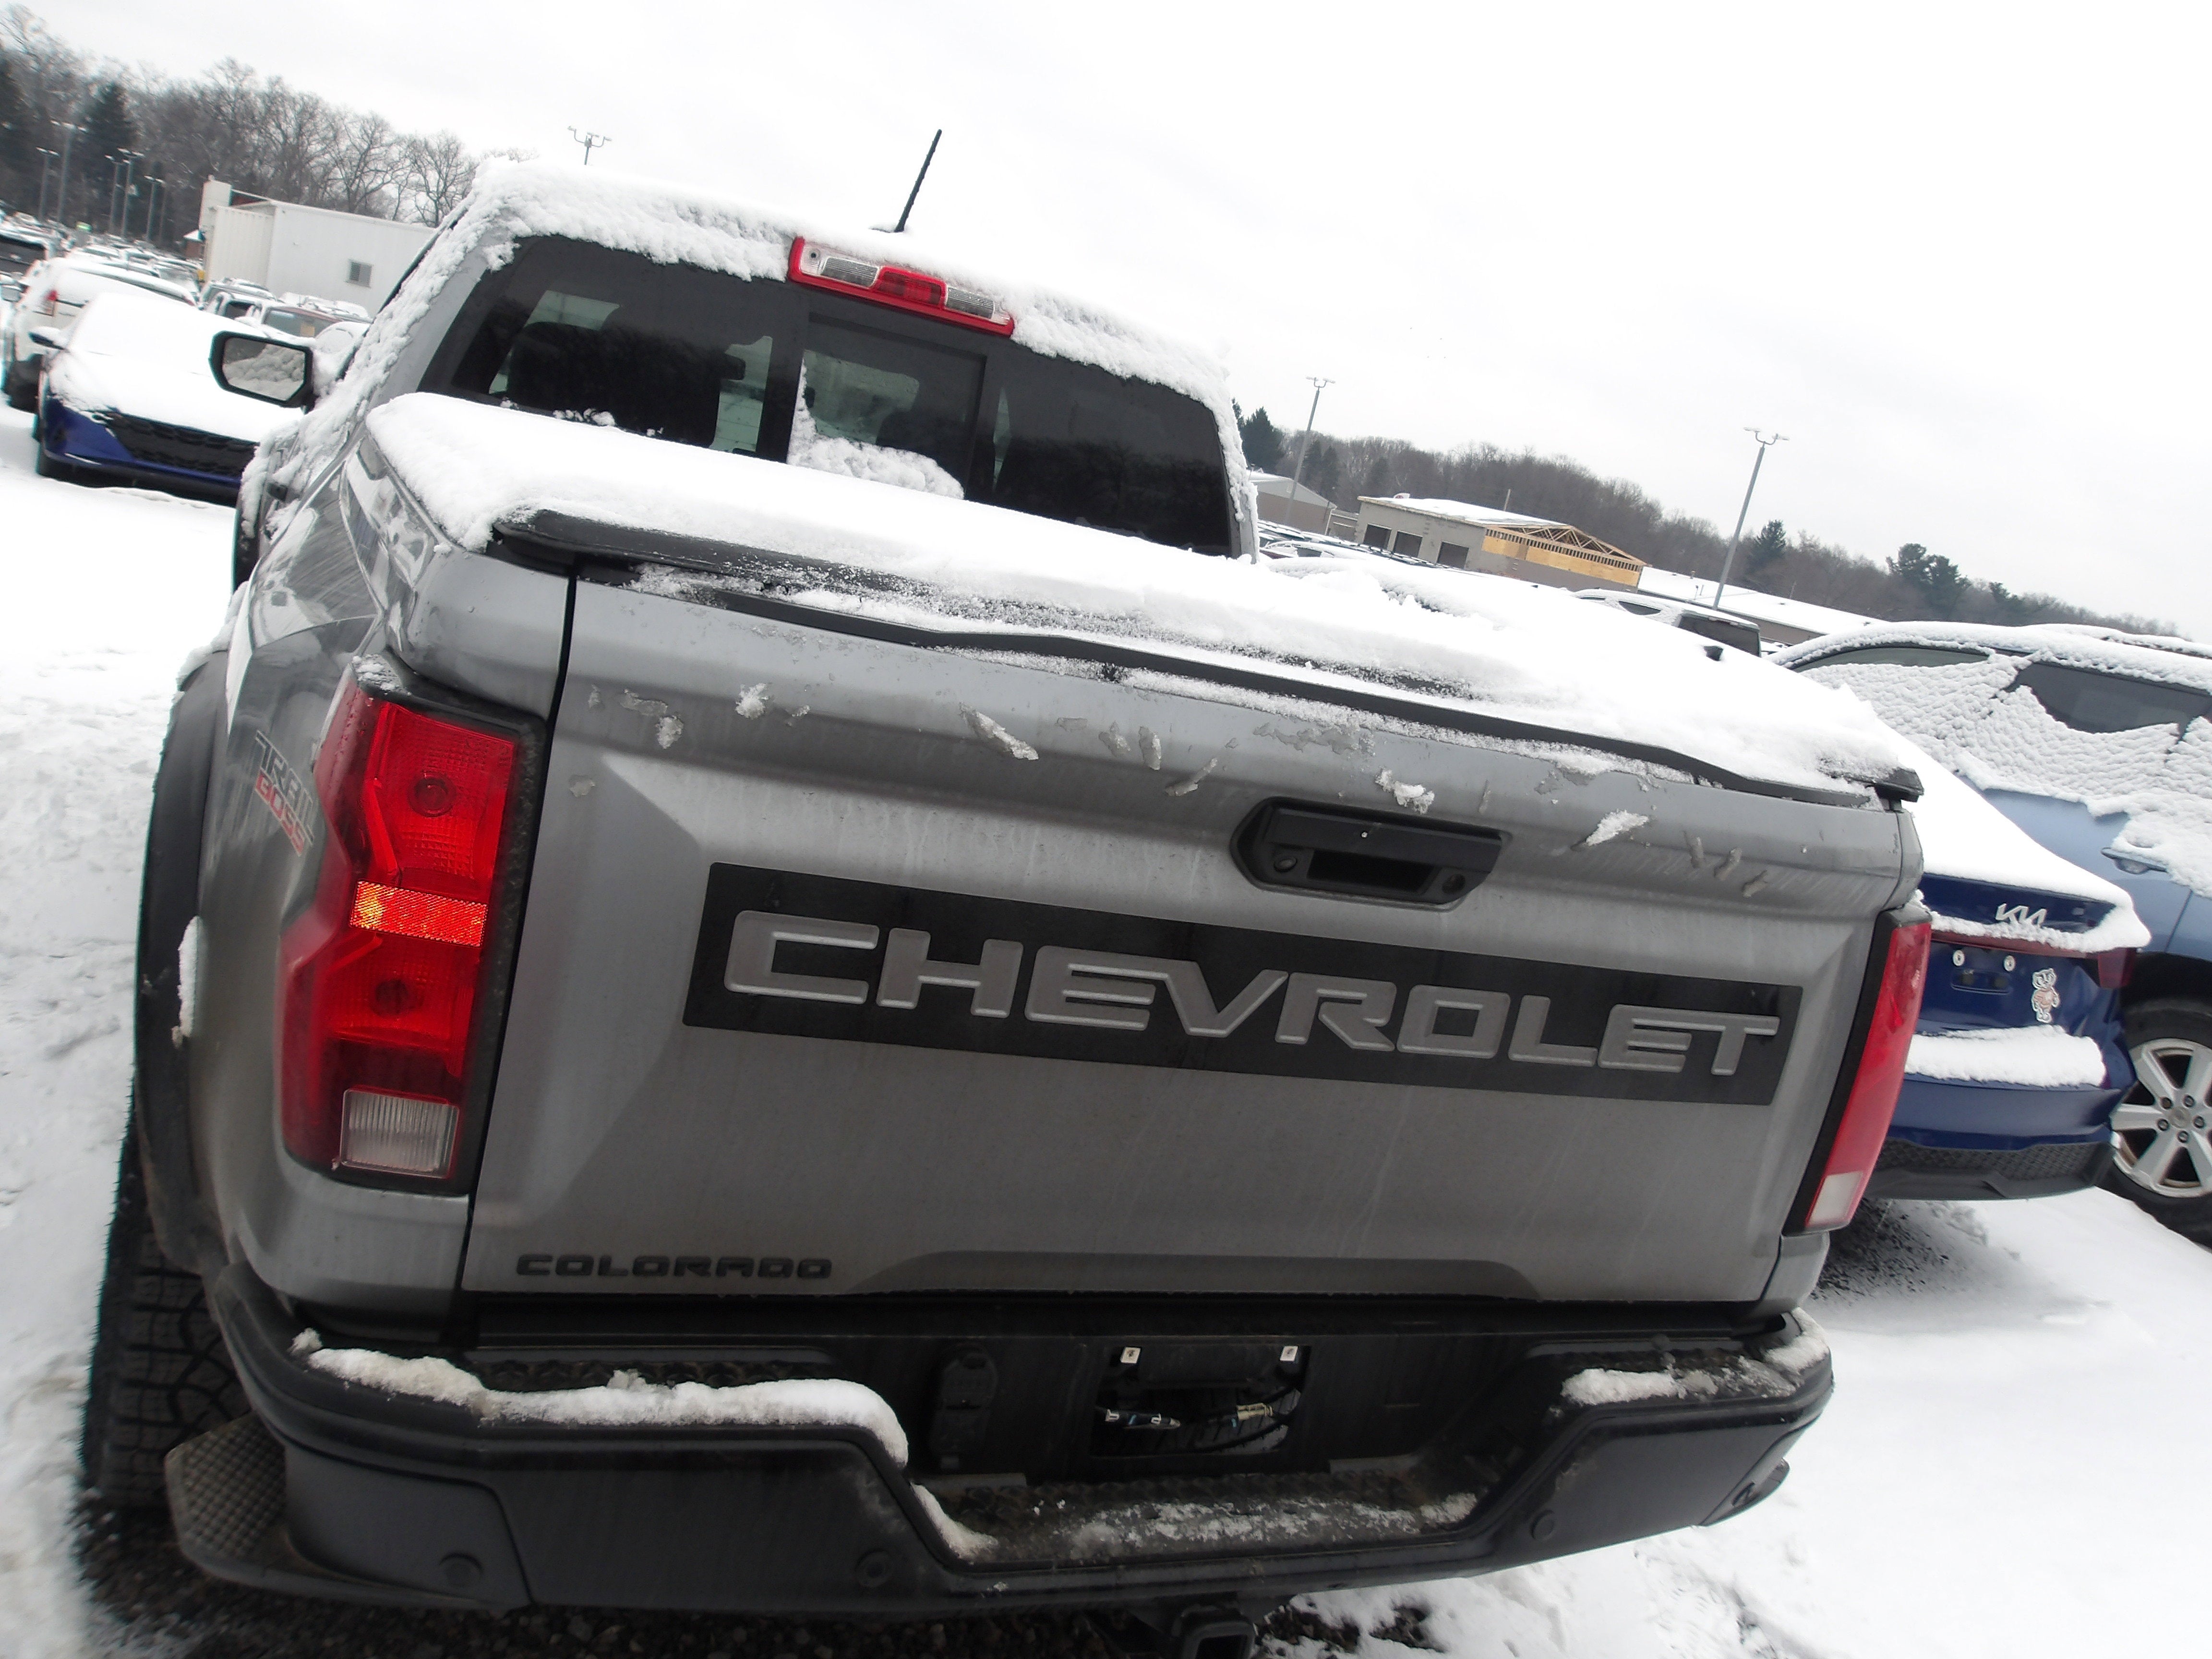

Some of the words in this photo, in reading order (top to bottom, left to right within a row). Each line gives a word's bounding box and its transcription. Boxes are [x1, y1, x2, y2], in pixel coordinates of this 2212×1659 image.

[255, 729, 314, 847] TRAIL
[255, 768, 305, 857] BOSS
[1996, 903, 2047, 928] KIA
[724, 910, 1780, 1076] CHEVROLET
[516, 1254, 832, 1279] COLORADO
